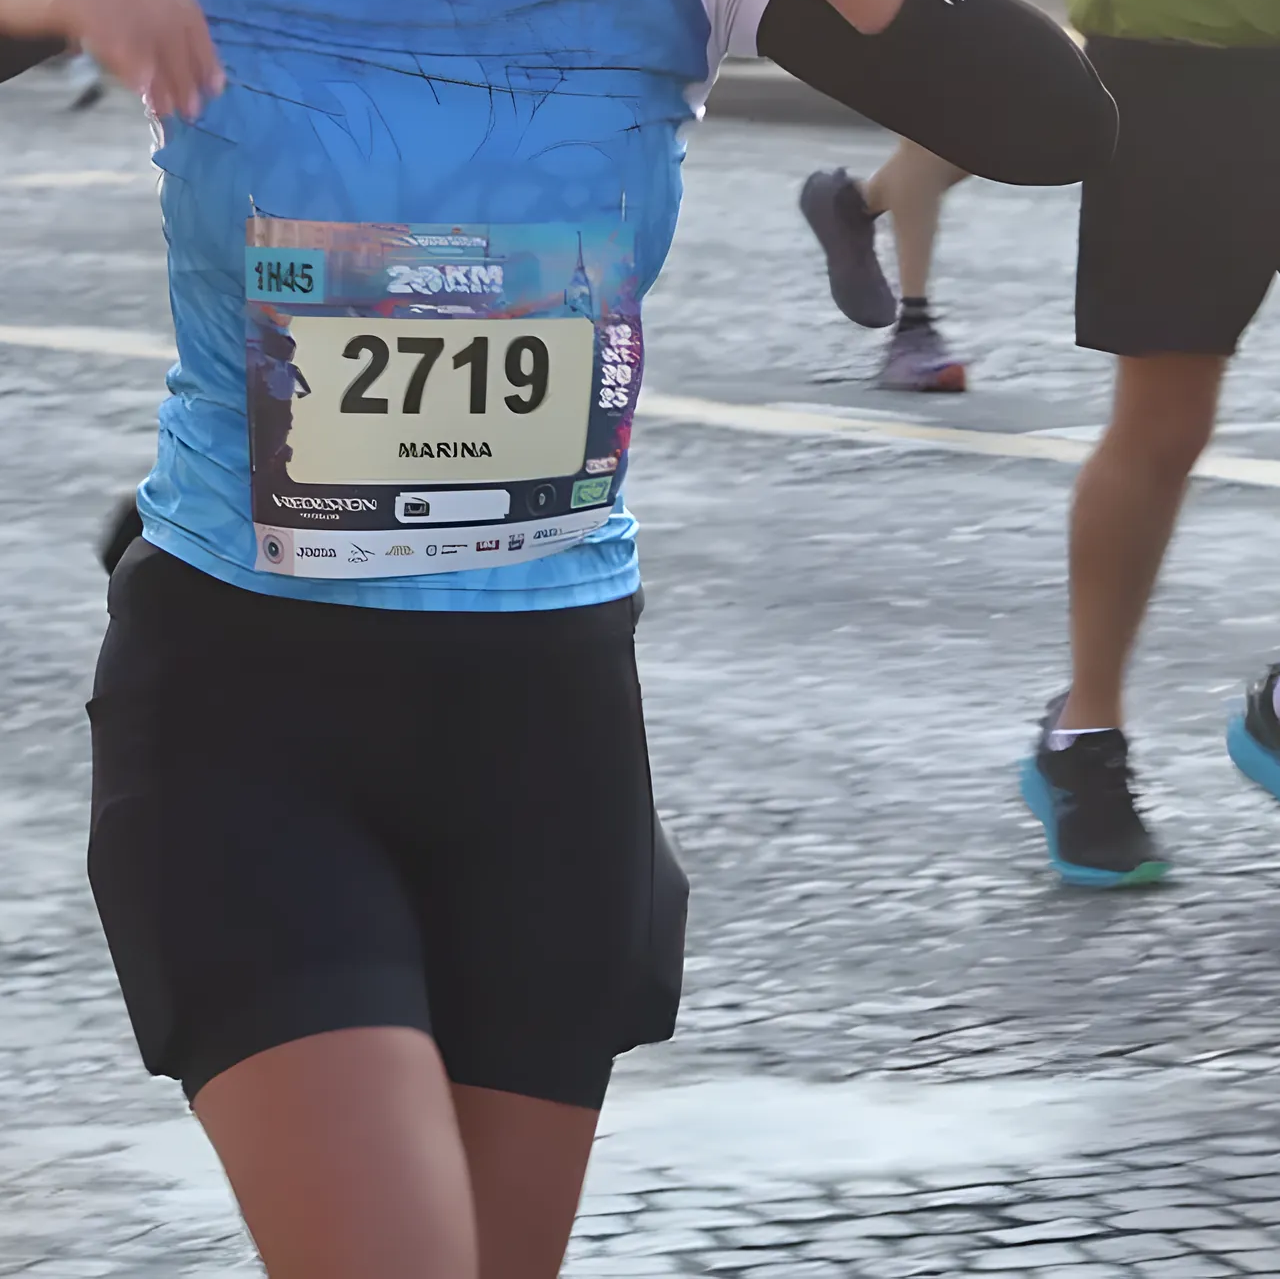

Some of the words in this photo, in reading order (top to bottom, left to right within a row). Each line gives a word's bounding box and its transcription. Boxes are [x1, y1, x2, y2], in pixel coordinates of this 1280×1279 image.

[254, 261, 314, 294] 1H45
[339, 334, 550, 415] 2719
[398, 441, 493, 459] MARINA
